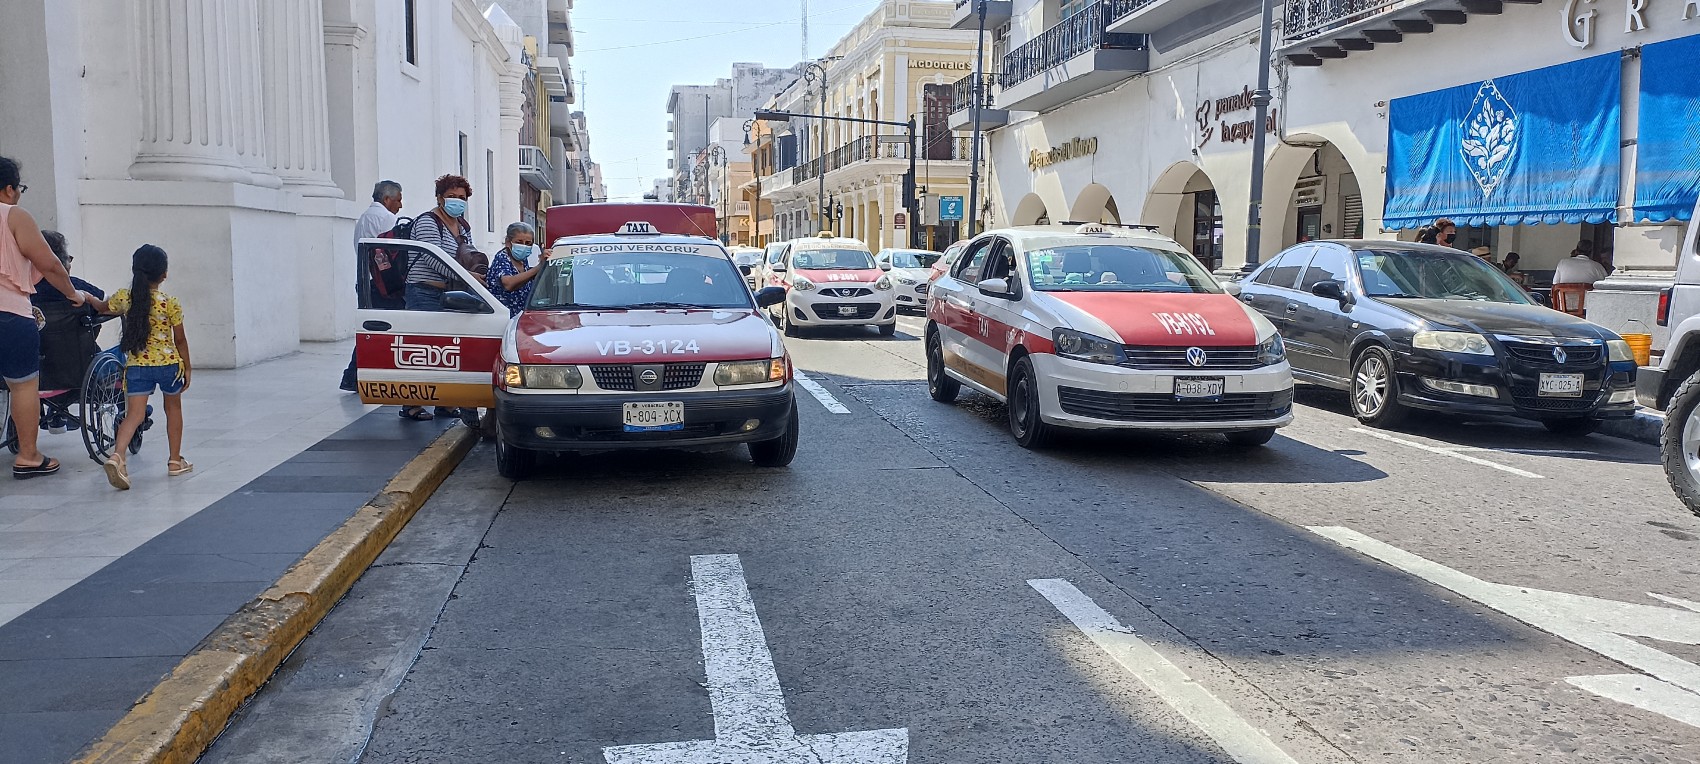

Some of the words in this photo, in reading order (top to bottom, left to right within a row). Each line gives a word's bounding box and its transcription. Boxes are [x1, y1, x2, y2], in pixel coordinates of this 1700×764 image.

[908, 60, 972, 70] McDonald's
[1215, 85, 1255, 121] panade
[1230, 108, 1277, 144] espeal
[626, 223, 649, 232] TAXI
[570, 245, 623, 255] REGION
[627, 244, 700, 254] VERACRUZ
[548, 258, 595, 267] VB-3124
[1152, 312, 1216, 336] VB-8192
[595, 339, 700, 356] VB-3124
[360, 381, 439, 400] VERACRUZ
[1540, 380, 1580, 391] XYC-025-A
[626, 410, 682, 423] A-804-XCX
